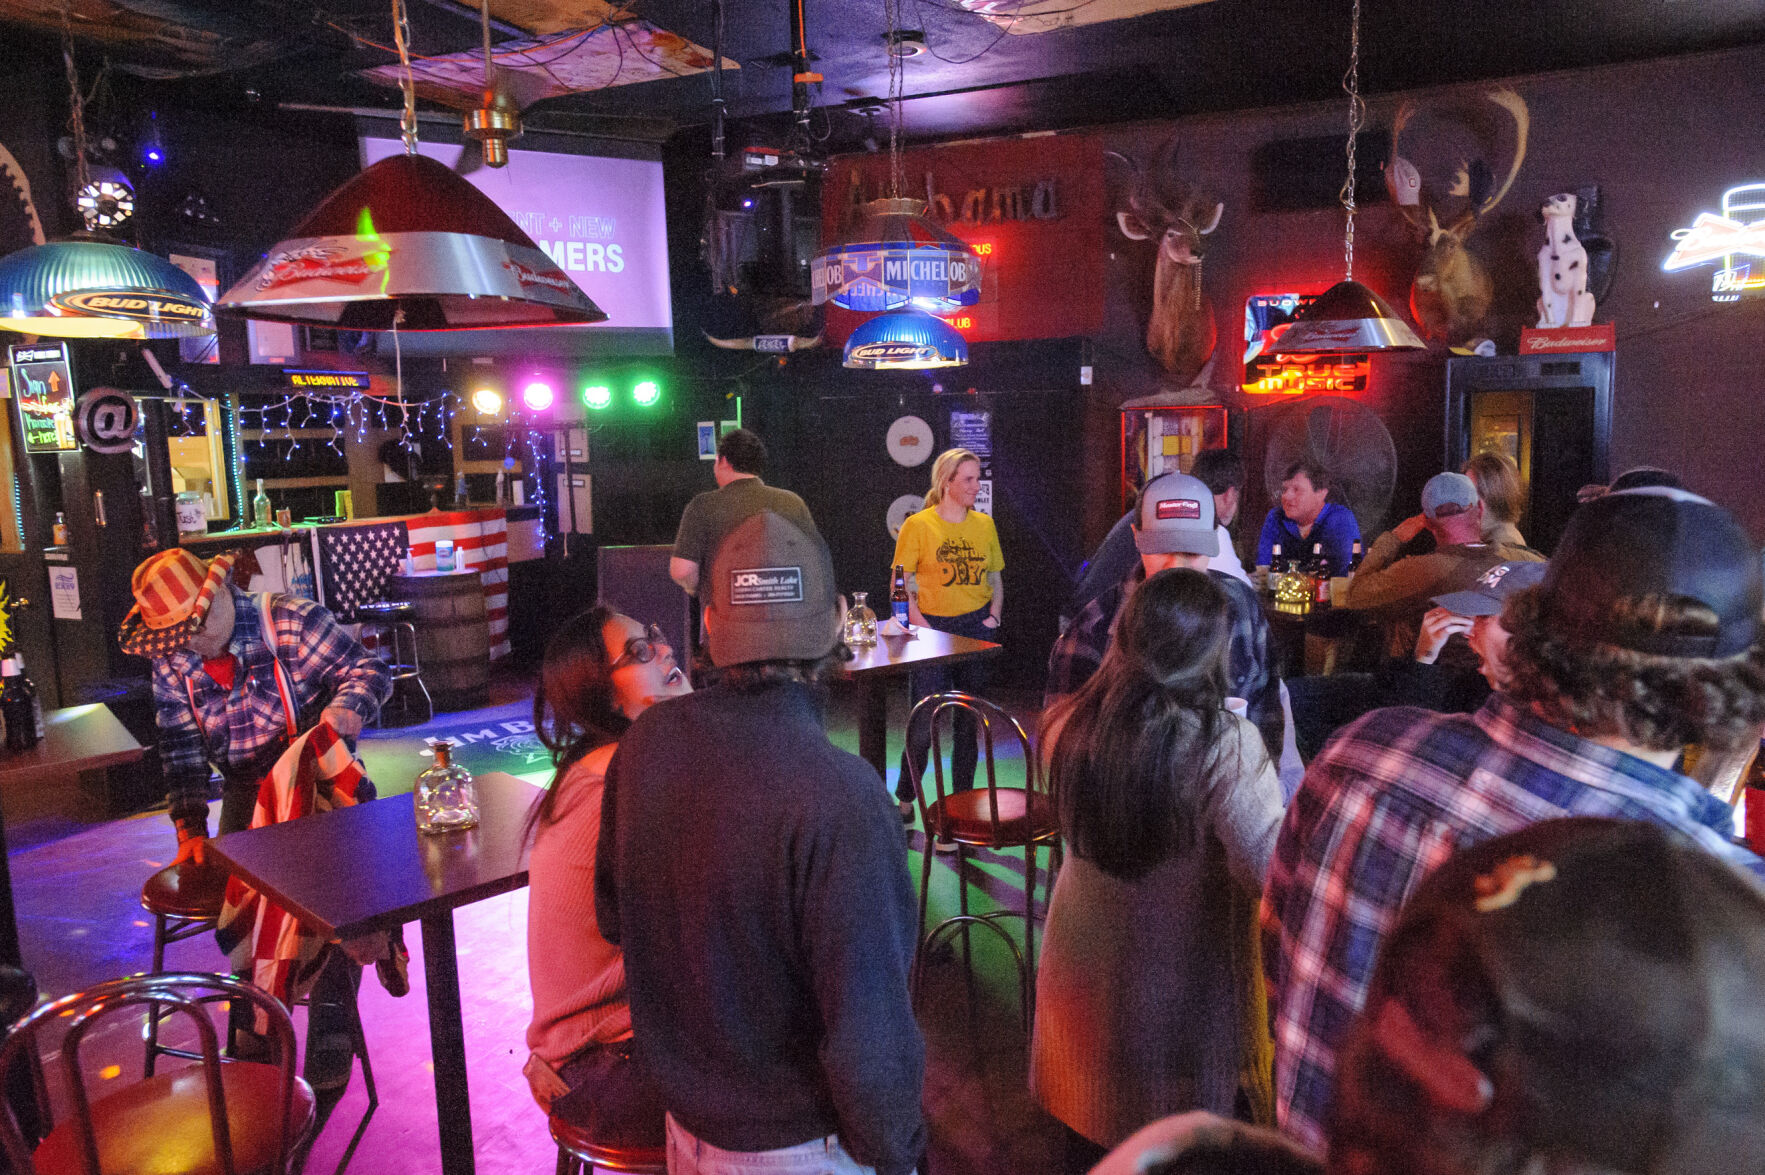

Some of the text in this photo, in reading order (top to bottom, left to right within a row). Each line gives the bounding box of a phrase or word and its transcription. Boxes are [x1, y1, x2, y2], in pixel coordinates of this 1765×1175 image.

[508, 212, 545, 236] NT
[568, 214, 617, 240] NEW
[886, 260, 966, 283] MICHELOB
[87, 296, 204, 318] BUD LIGHT
[859, 346, 928, 356] BUD LIGHT
[1526, 336, 1607, 350] Budweiser
[734, 573, 760, 587] JCR
